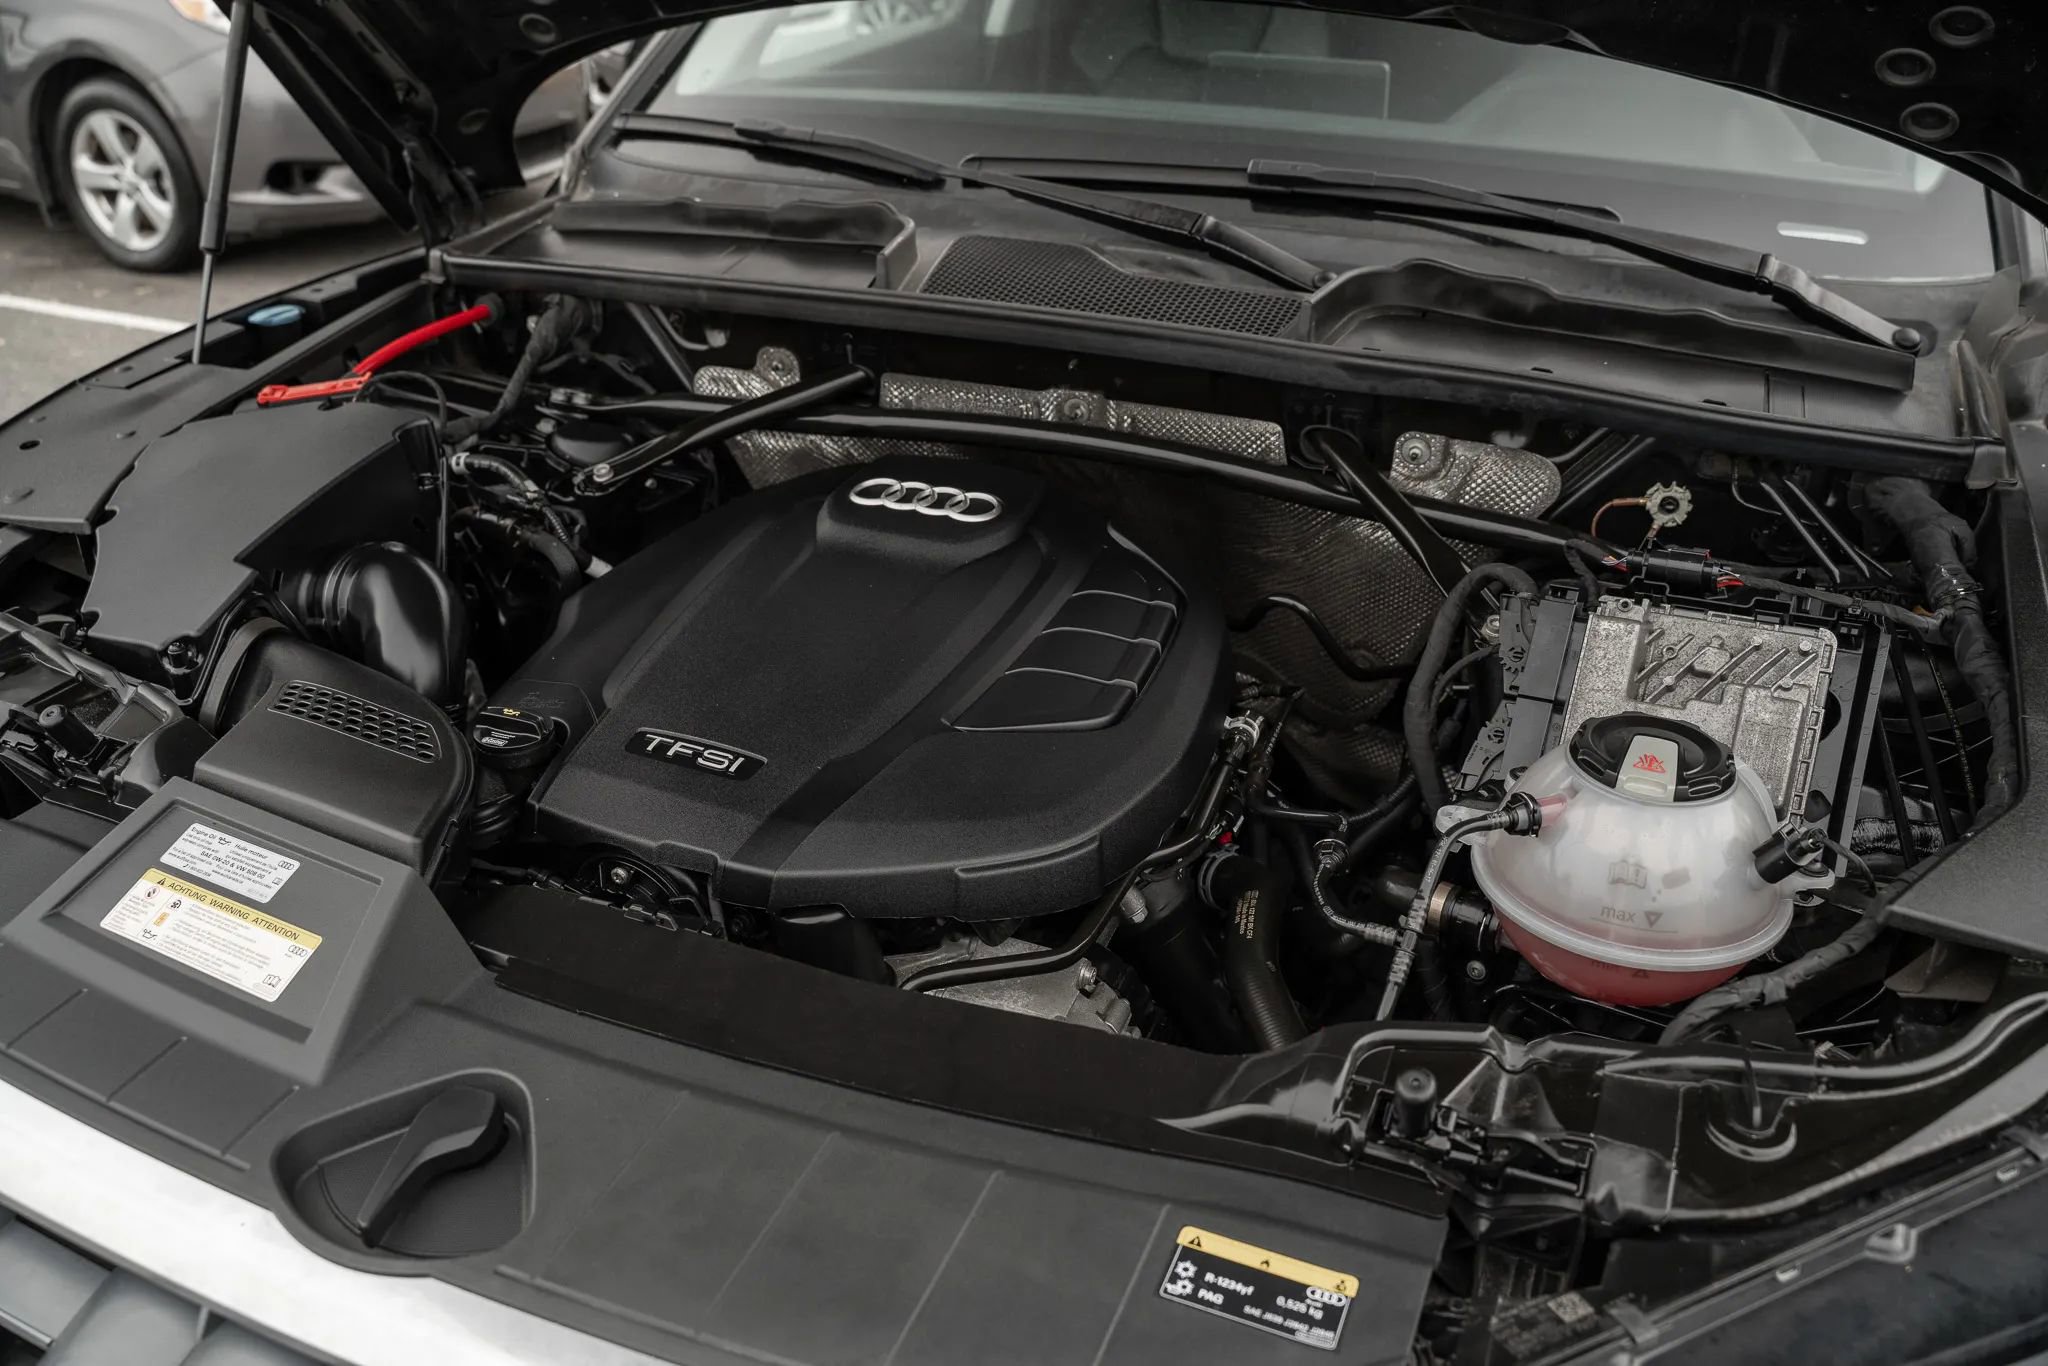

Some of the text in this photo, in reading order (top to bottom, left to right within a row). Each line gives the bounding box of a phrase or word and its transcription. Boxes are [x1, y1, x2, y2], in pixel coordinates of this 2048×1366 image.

[646, 733, 745, 775] TFSI
[191, 826, 208, 836] Engine
[200, 850, 213, 859] SAE
[236, 864, 248, 872] VW
[248, 849, 268, 859] moteur
[168, 882, 207, 902] ACHTUNG
[209, 898, 250, 920] WARNING
[251, 917, 300, 941] ATTENTION
[1600, 905, 1637, 923] max
[1197, 1288, 1225, 1306] PAG
